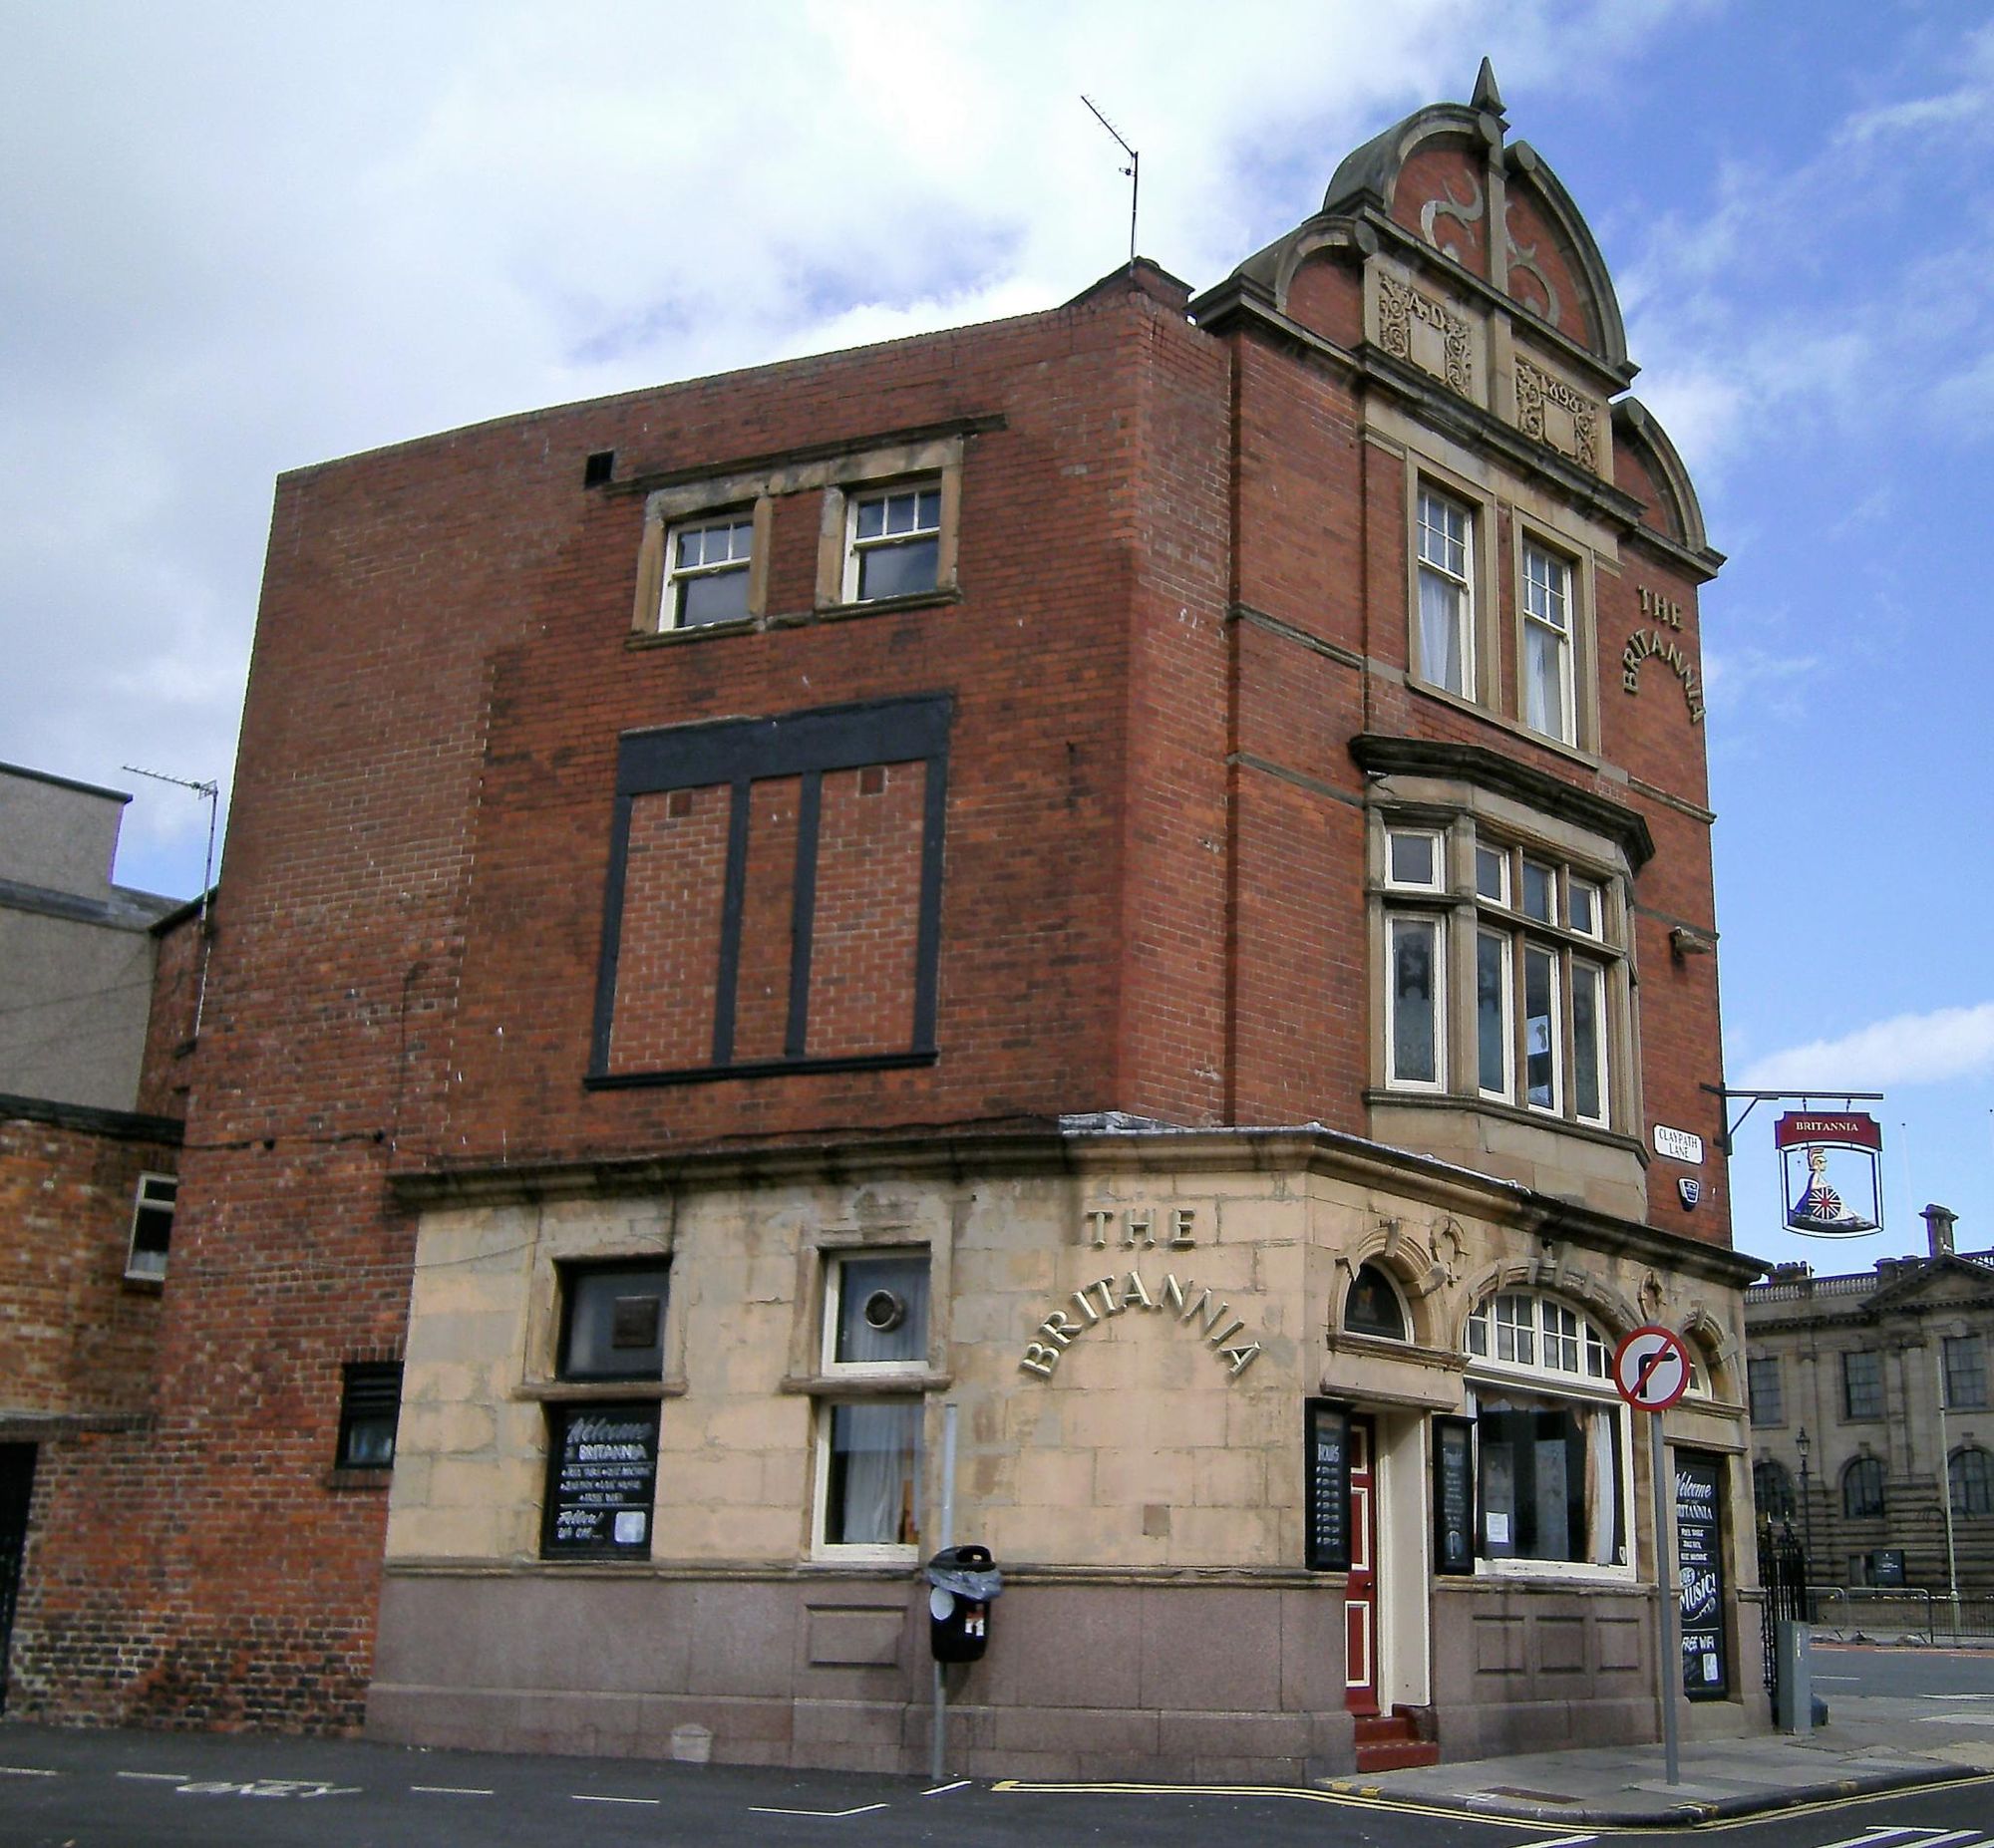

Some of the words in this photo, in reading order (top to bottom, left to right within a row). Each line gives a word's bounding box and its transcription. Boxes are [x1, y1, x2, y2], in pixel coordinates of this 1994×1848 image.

[1637, 584, 1683, 630] THE
[1622, 628, 1707, 724] BRITANNIA
[1658, 1127, 1698, 1149] CLAYPATH
[1796, 1120, 1859, 1132] BRITANNIA
[1668, 1142, 1690, 1158] LANE
[1088, 1209, 1196, 1248] THE
[1020, 1270, 1261, 1377] BRITANNIA
[1679, 1573, 1717, 1612] MUSIC!
